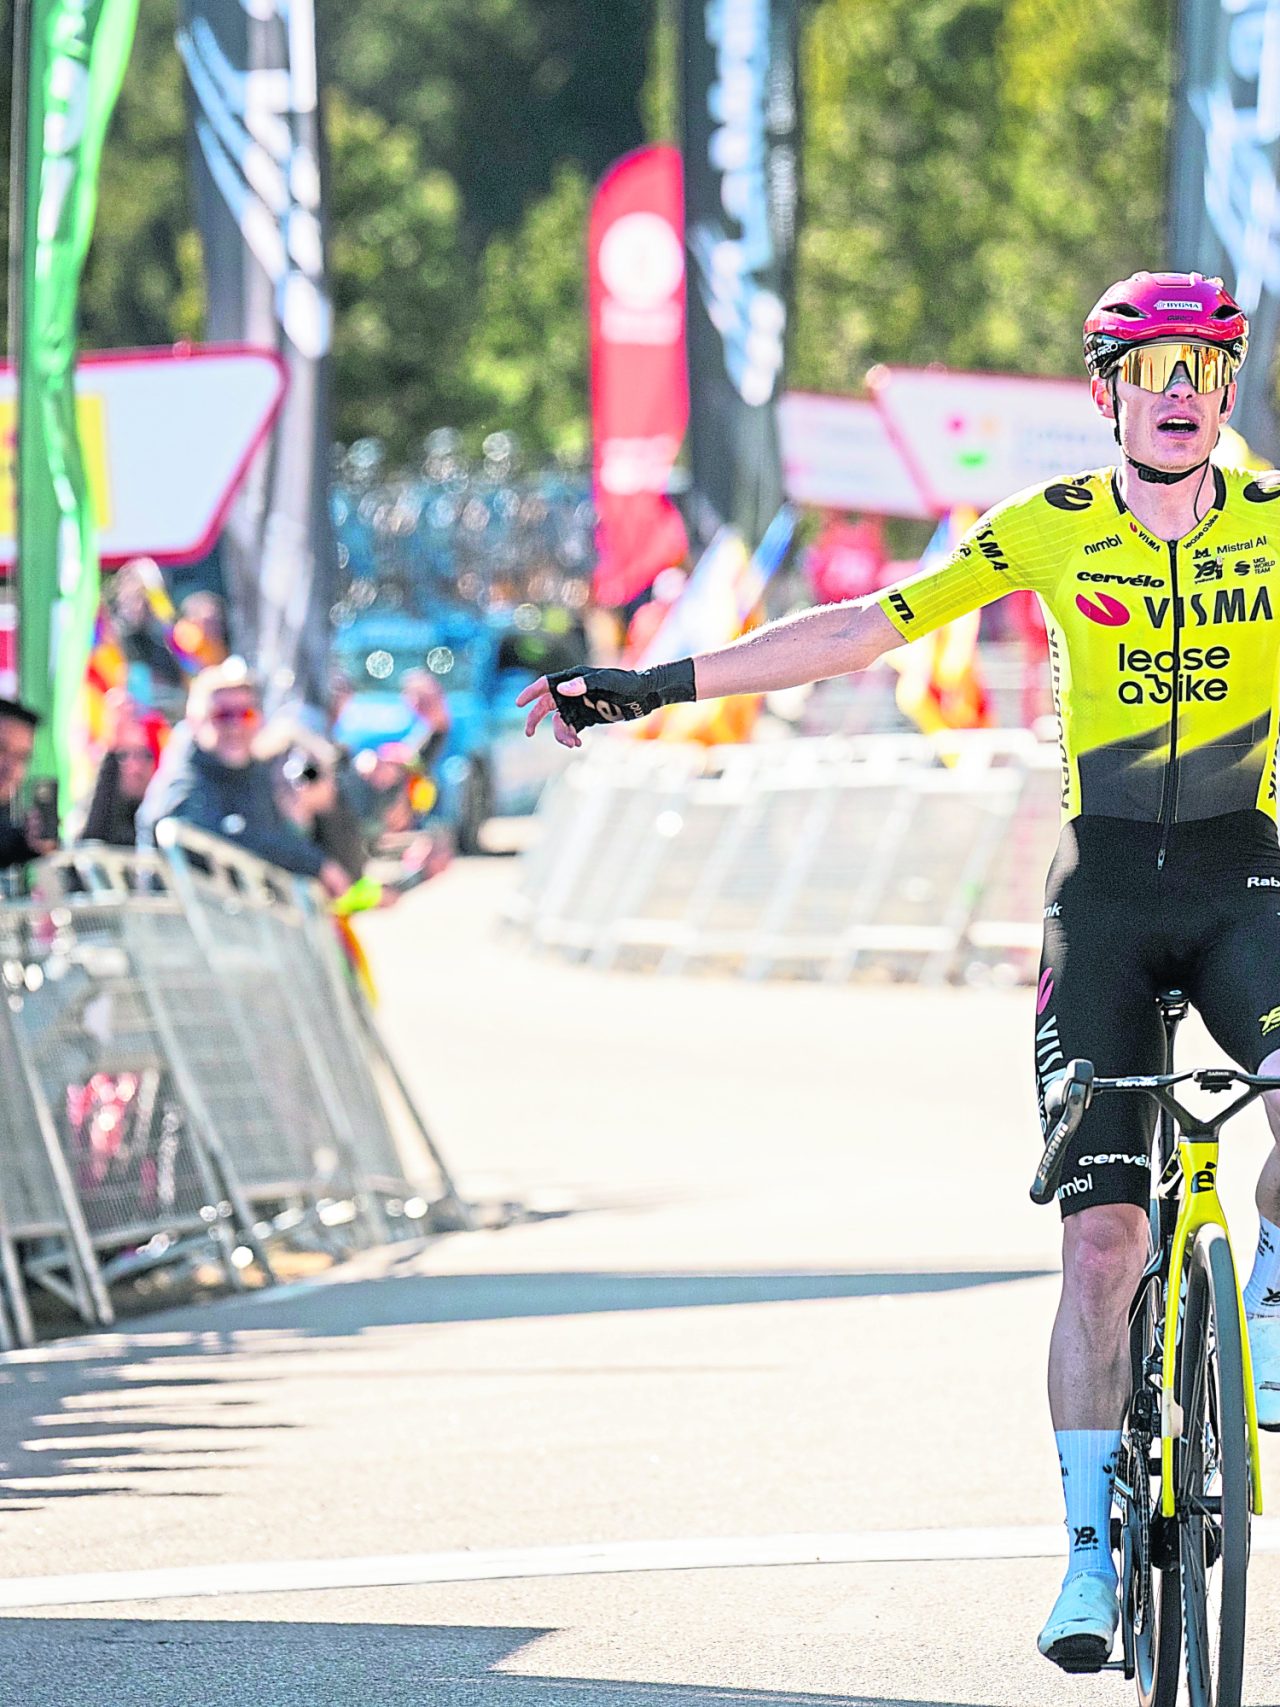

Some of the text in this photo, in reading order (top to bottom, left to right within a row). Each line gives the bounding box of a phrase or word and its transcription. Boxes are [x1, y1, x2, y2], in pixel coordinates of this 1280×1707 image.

[1084, 533, 1123, 555] nimbl
[1138, 531, 1161, 552] VISMA
[1216, 535, 1267, 554] Mistral AI
[1253, 560, 1276, 569] WORLD
[1076, 571, 1165, 588] cervélo
[1144, 586, 1273, 629] VISMA
[1118, 643, 1230, 673] lease
[1057, 1173, 1093, 1200] imbl
